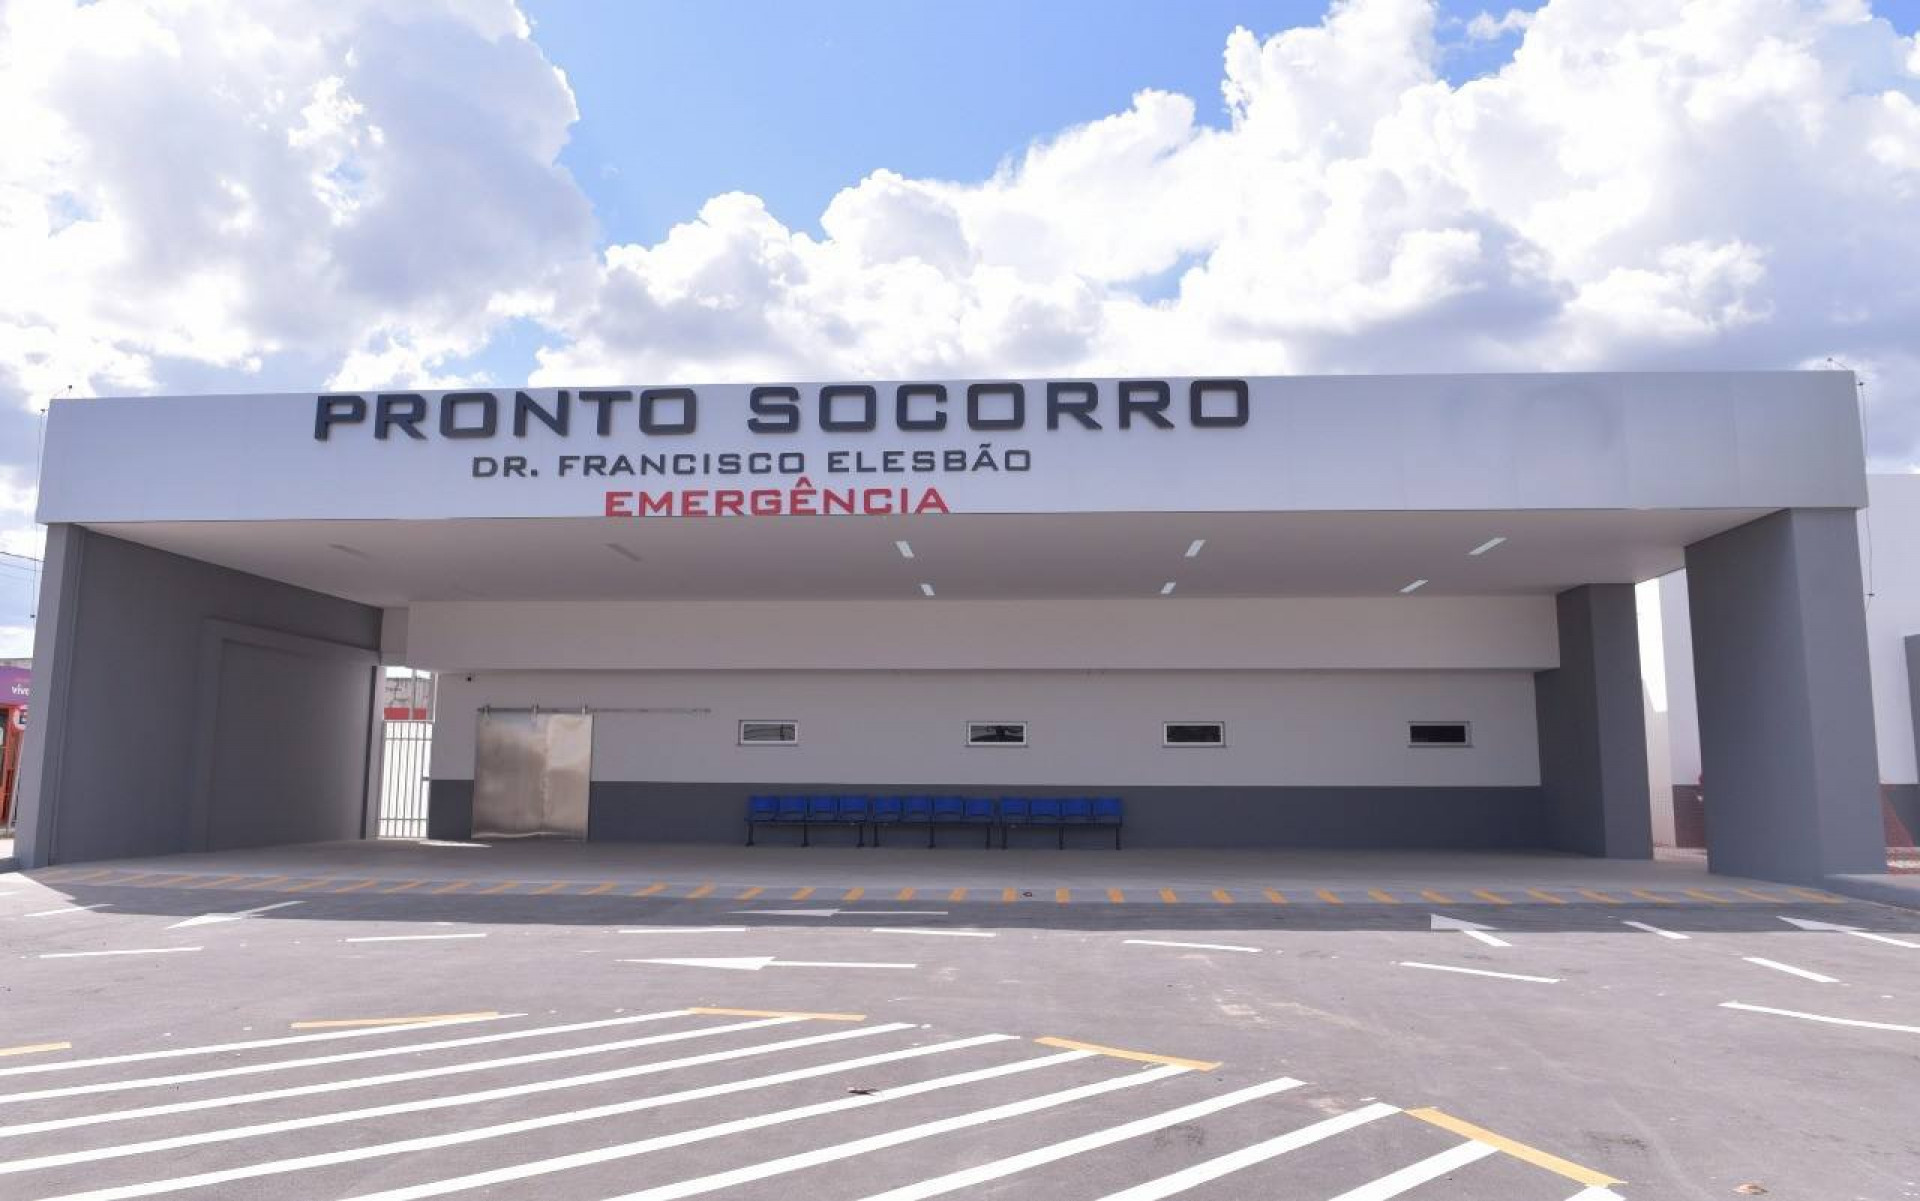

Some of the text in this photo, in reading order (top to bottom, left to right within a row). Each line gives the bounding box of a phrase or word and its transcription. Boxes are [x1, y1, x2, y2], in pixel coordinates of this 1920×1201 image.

[314, 380, 1249, 441] PRONTO SOCORRO
[472, 443, 1031, 478] DR. FRANCISCO ELESBÃO
[605, 477, 950, 517] EMERGÊNCIA
